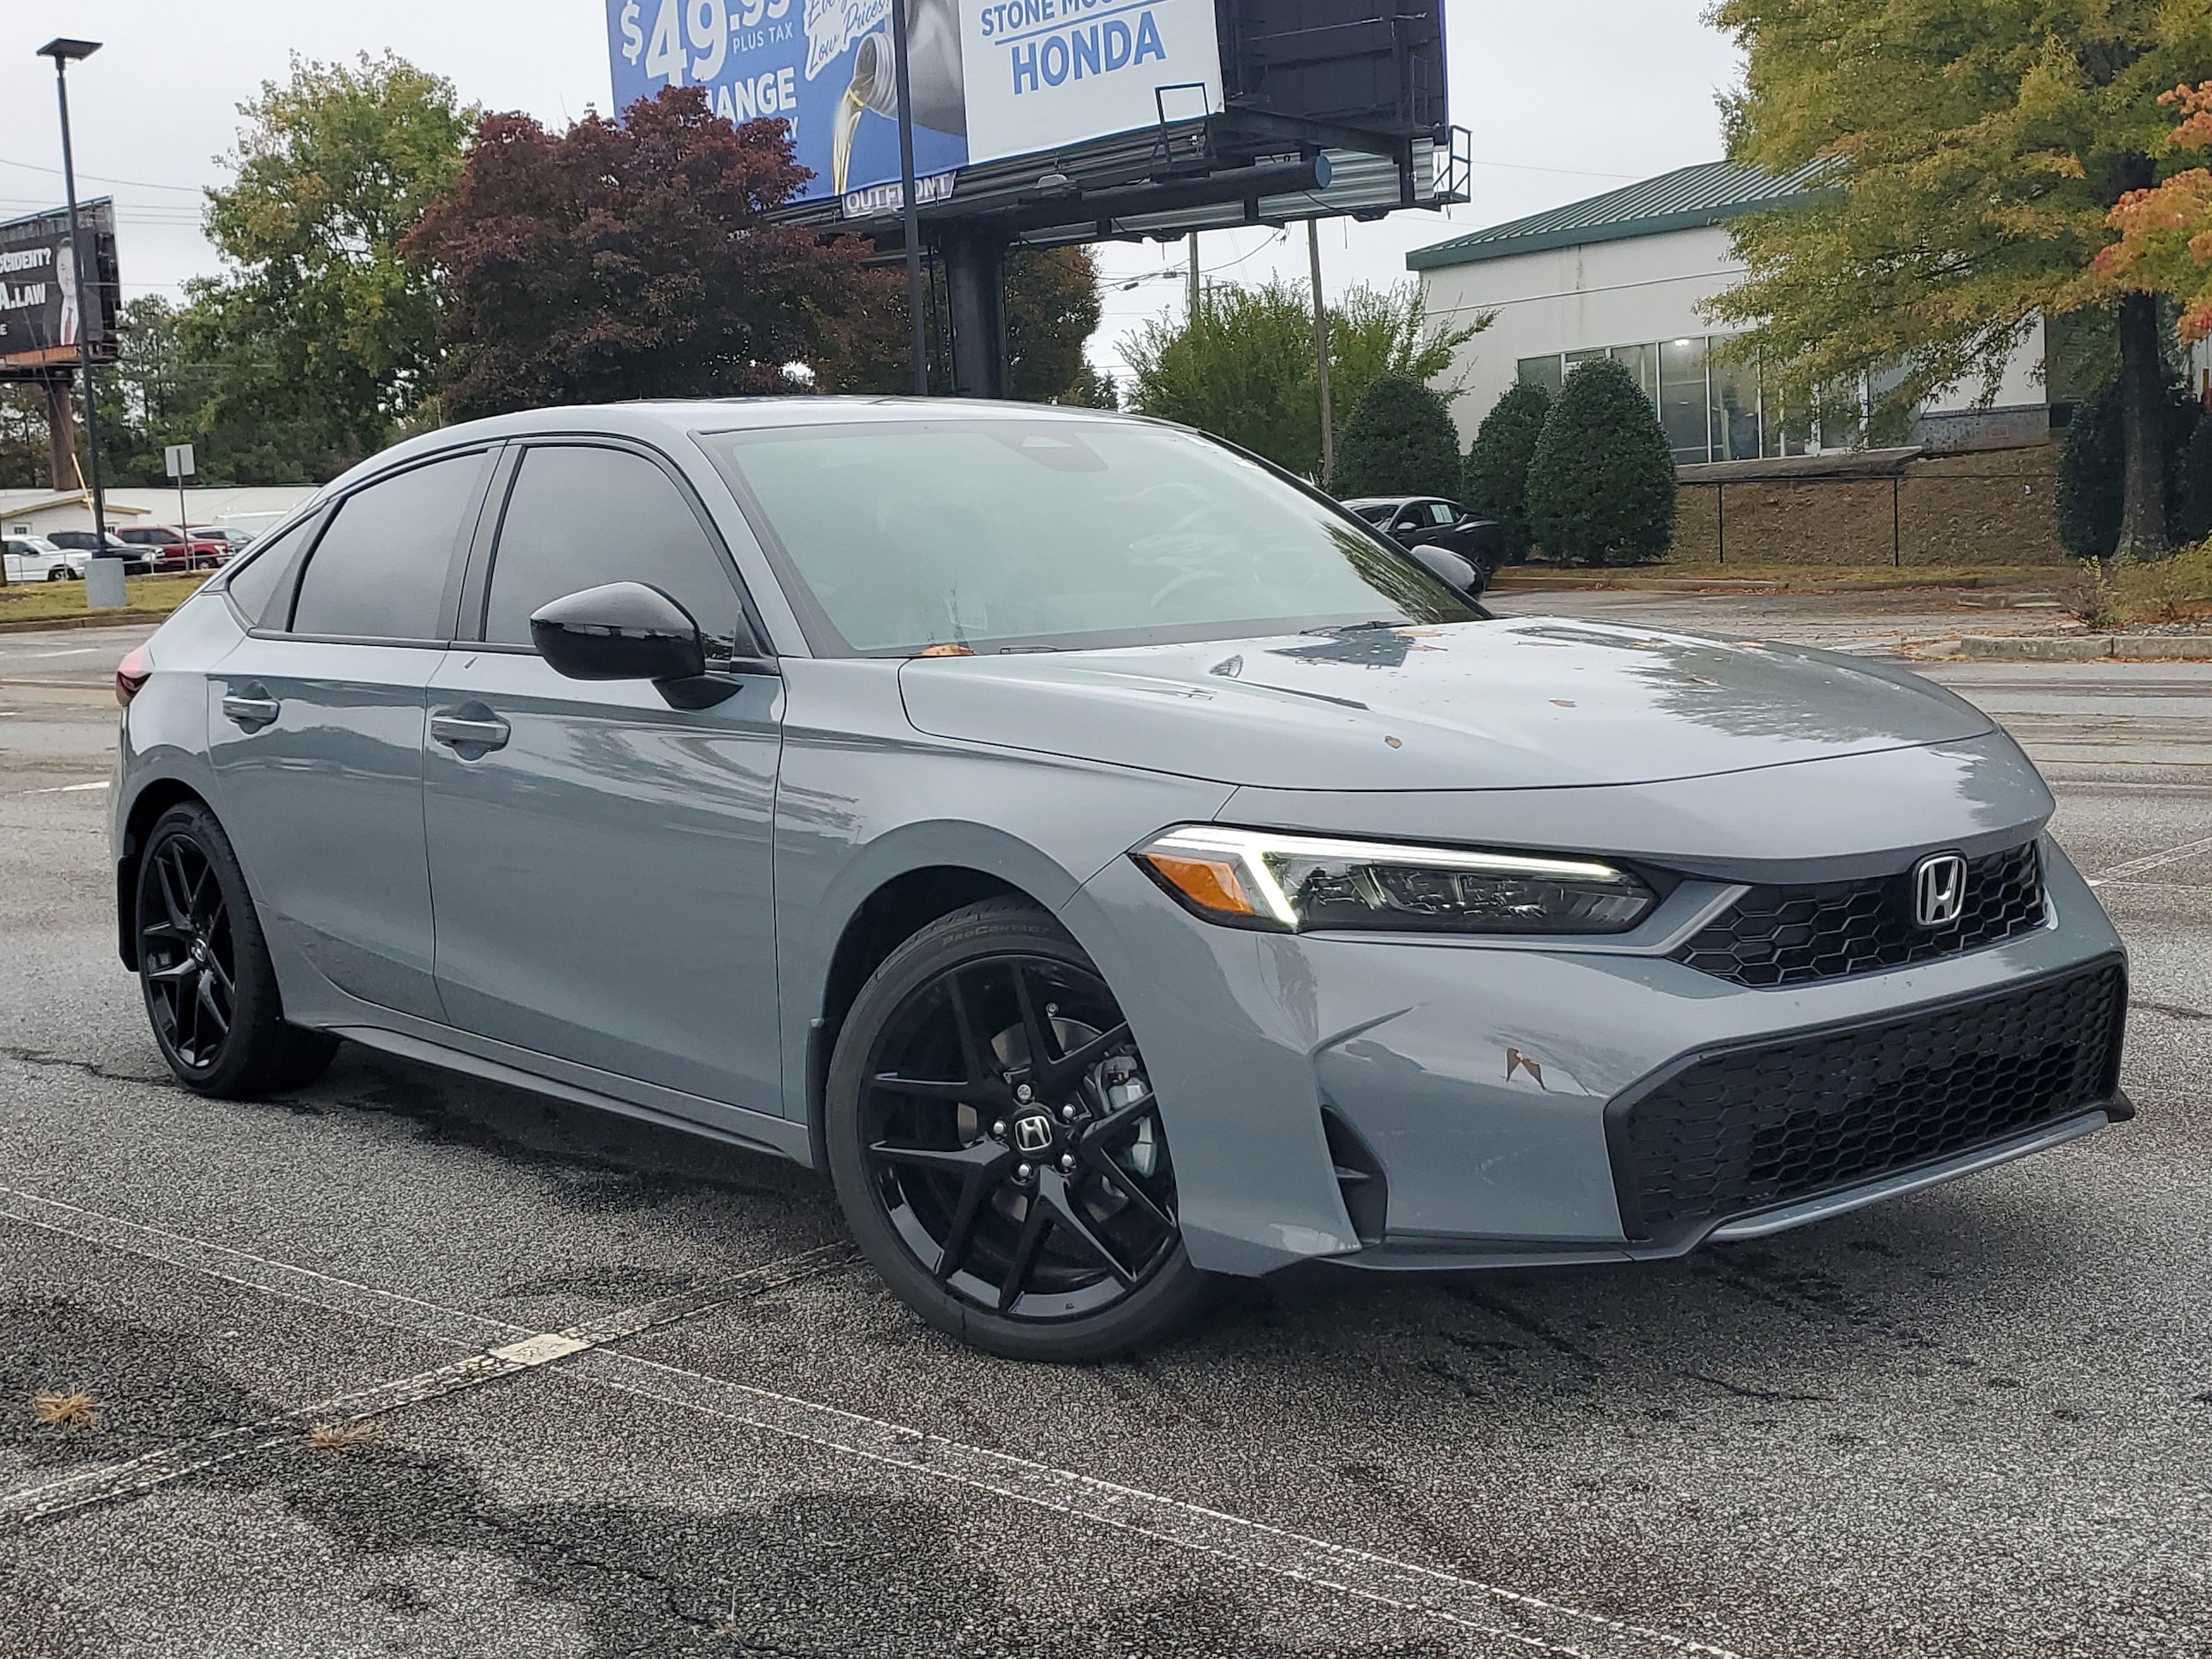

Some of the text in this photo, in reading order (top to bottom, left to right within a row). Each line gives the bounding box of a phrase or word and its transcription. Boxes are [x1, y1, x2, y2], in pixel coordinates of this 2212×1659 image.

[980, 0, 1056, 37] STONE
[733, 21, 794, 55] PLUS TAX
[809, 34, 840, 74] Low
[1010, 10, 1167, 96] HONDA
[846, 174, 954, 212] OUTFONT
